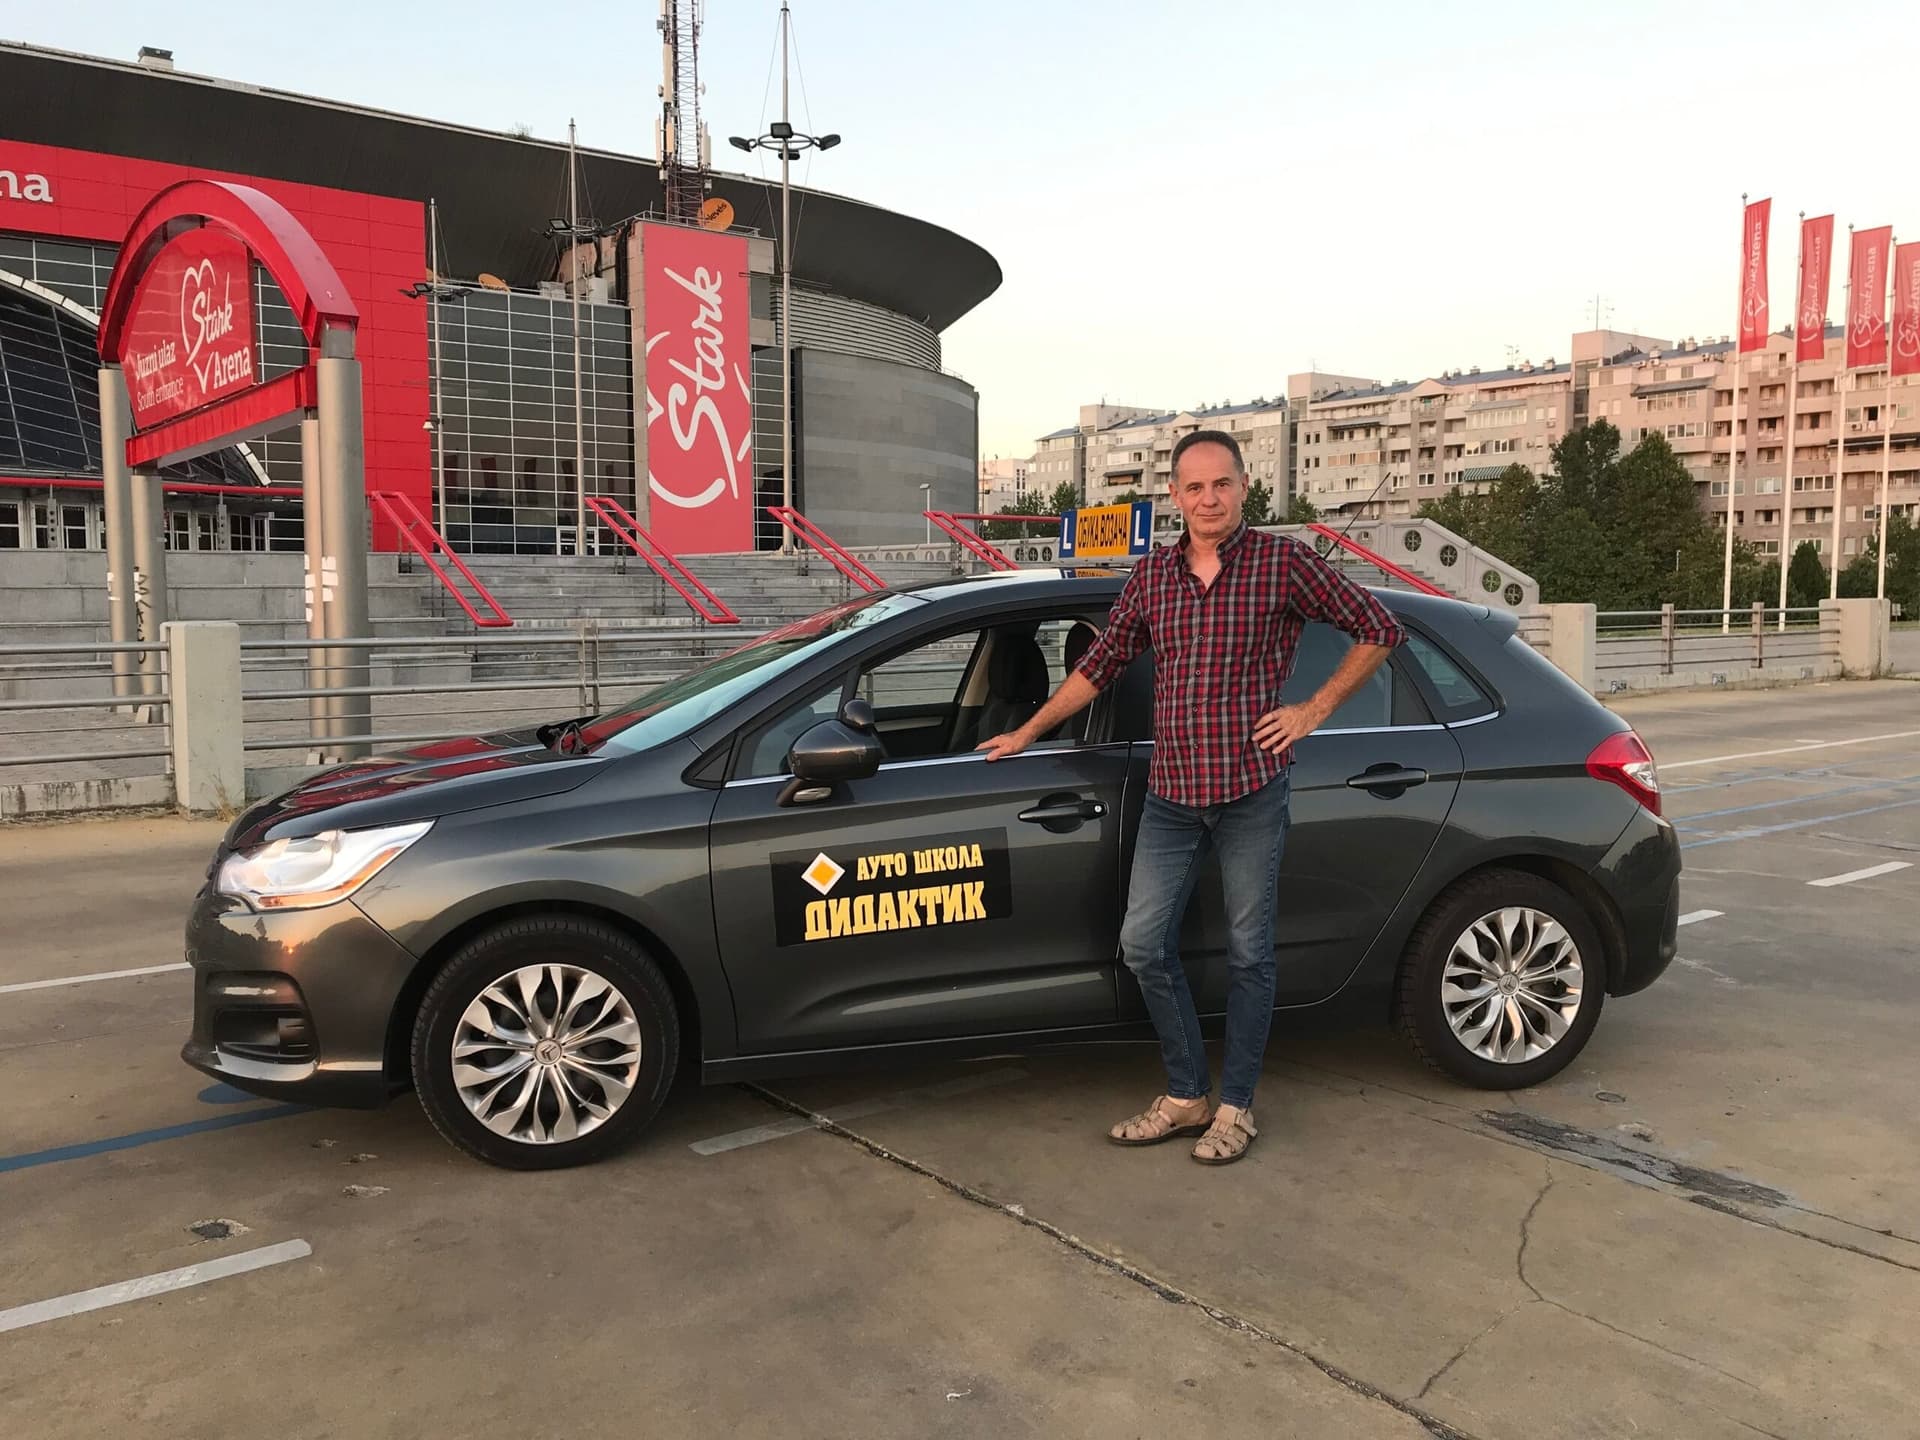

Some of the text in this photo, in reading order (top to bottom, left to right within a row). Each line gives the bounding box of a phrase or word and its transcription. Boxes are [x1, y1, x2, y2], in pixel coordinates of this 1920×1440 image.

[188, 272, 232, 362] Stark
[158, 339, 176, 369] ulaz
[213, 346, 252, 389] Arena
[664, 266, 737, 498] Stark
[1077, 515, 1099, 548] ОБУКА
[1100, 511, 1128, 548] ВОЗАЧА
[856, 843, 984, 881] АУТО ШКОЛА
[804, 880, 987, 941] ДИДАКТИК
